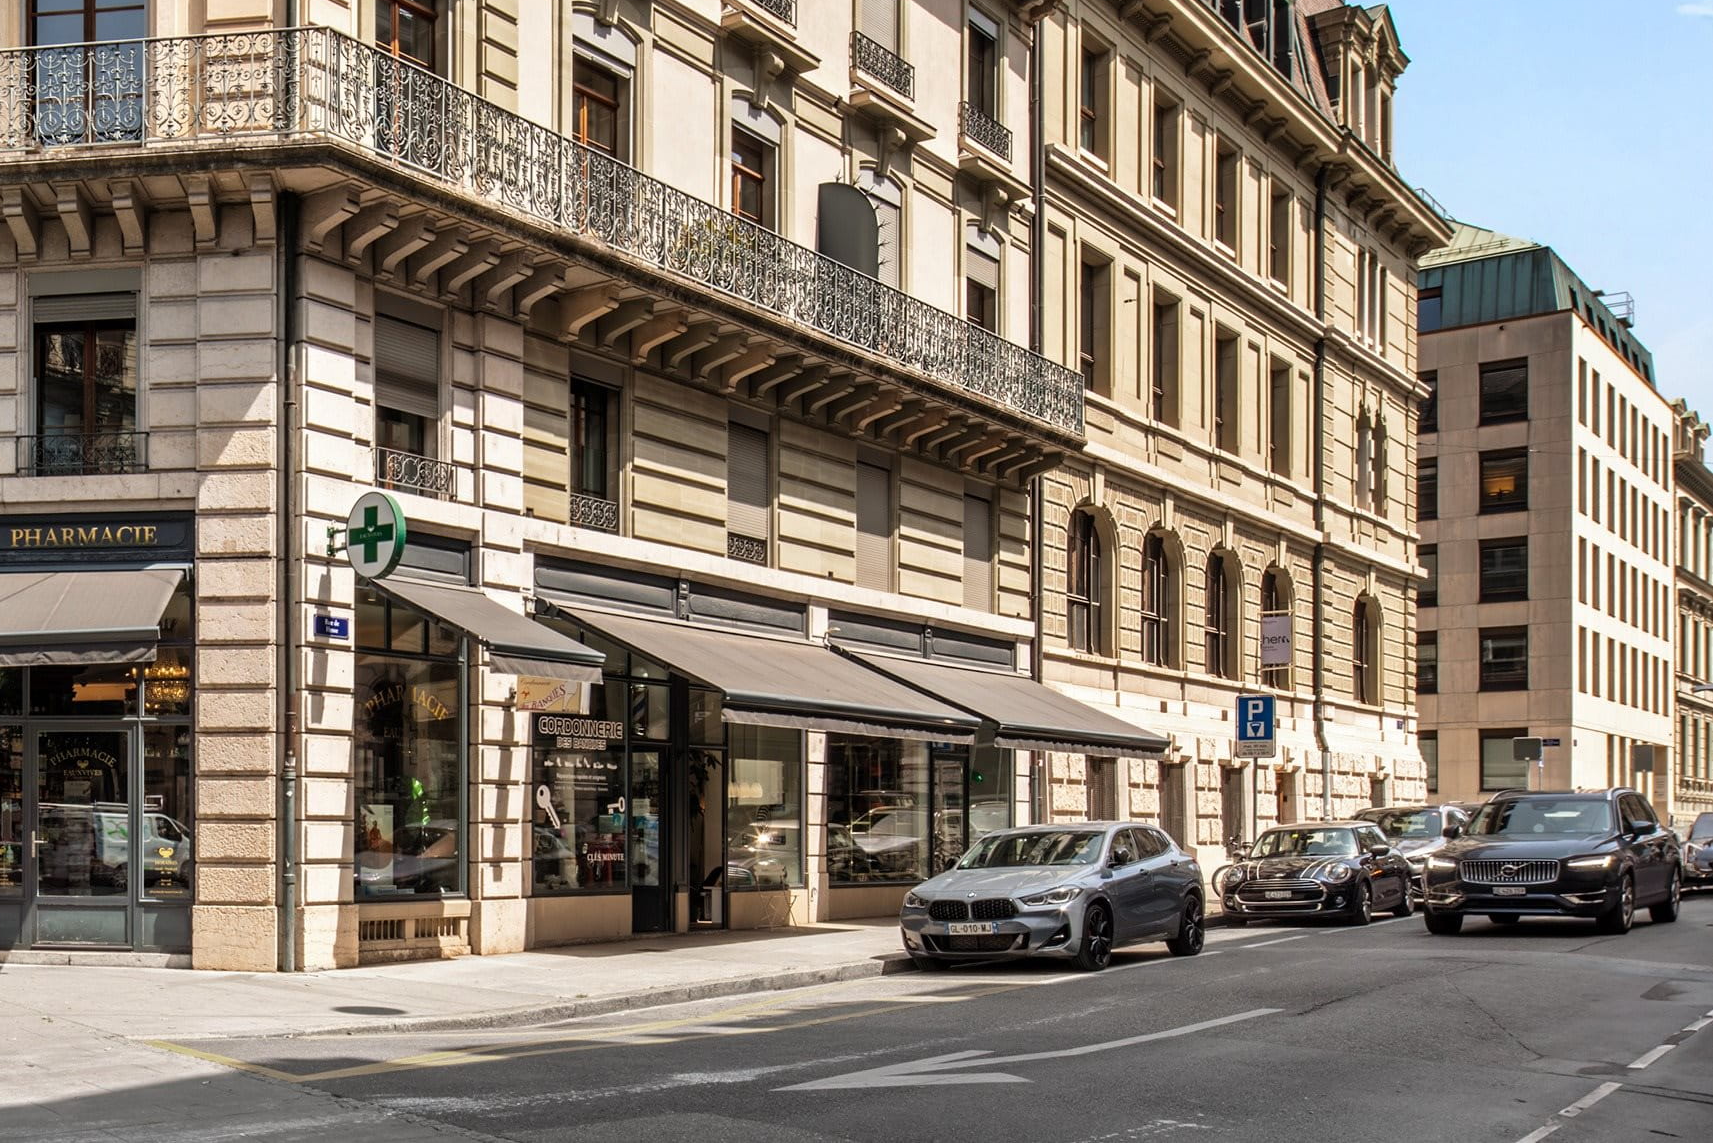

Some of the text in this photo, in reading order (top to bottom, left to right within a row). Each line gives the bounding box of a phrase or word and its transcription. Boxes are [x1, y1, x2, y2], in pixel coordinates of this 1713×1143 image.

[10, 526, 158, 548] PHARMACIE
[531, 684, 566, 708] BANQUES
[1248, 700, 1264, 721] P
[539, 716, 623, 739] CORDONNERIE
[556, 737, 607, 751] DES BANQUES
[50, 748, 117, 768] PHARMACIE
[602, 853, 624, 861] MINUTE
